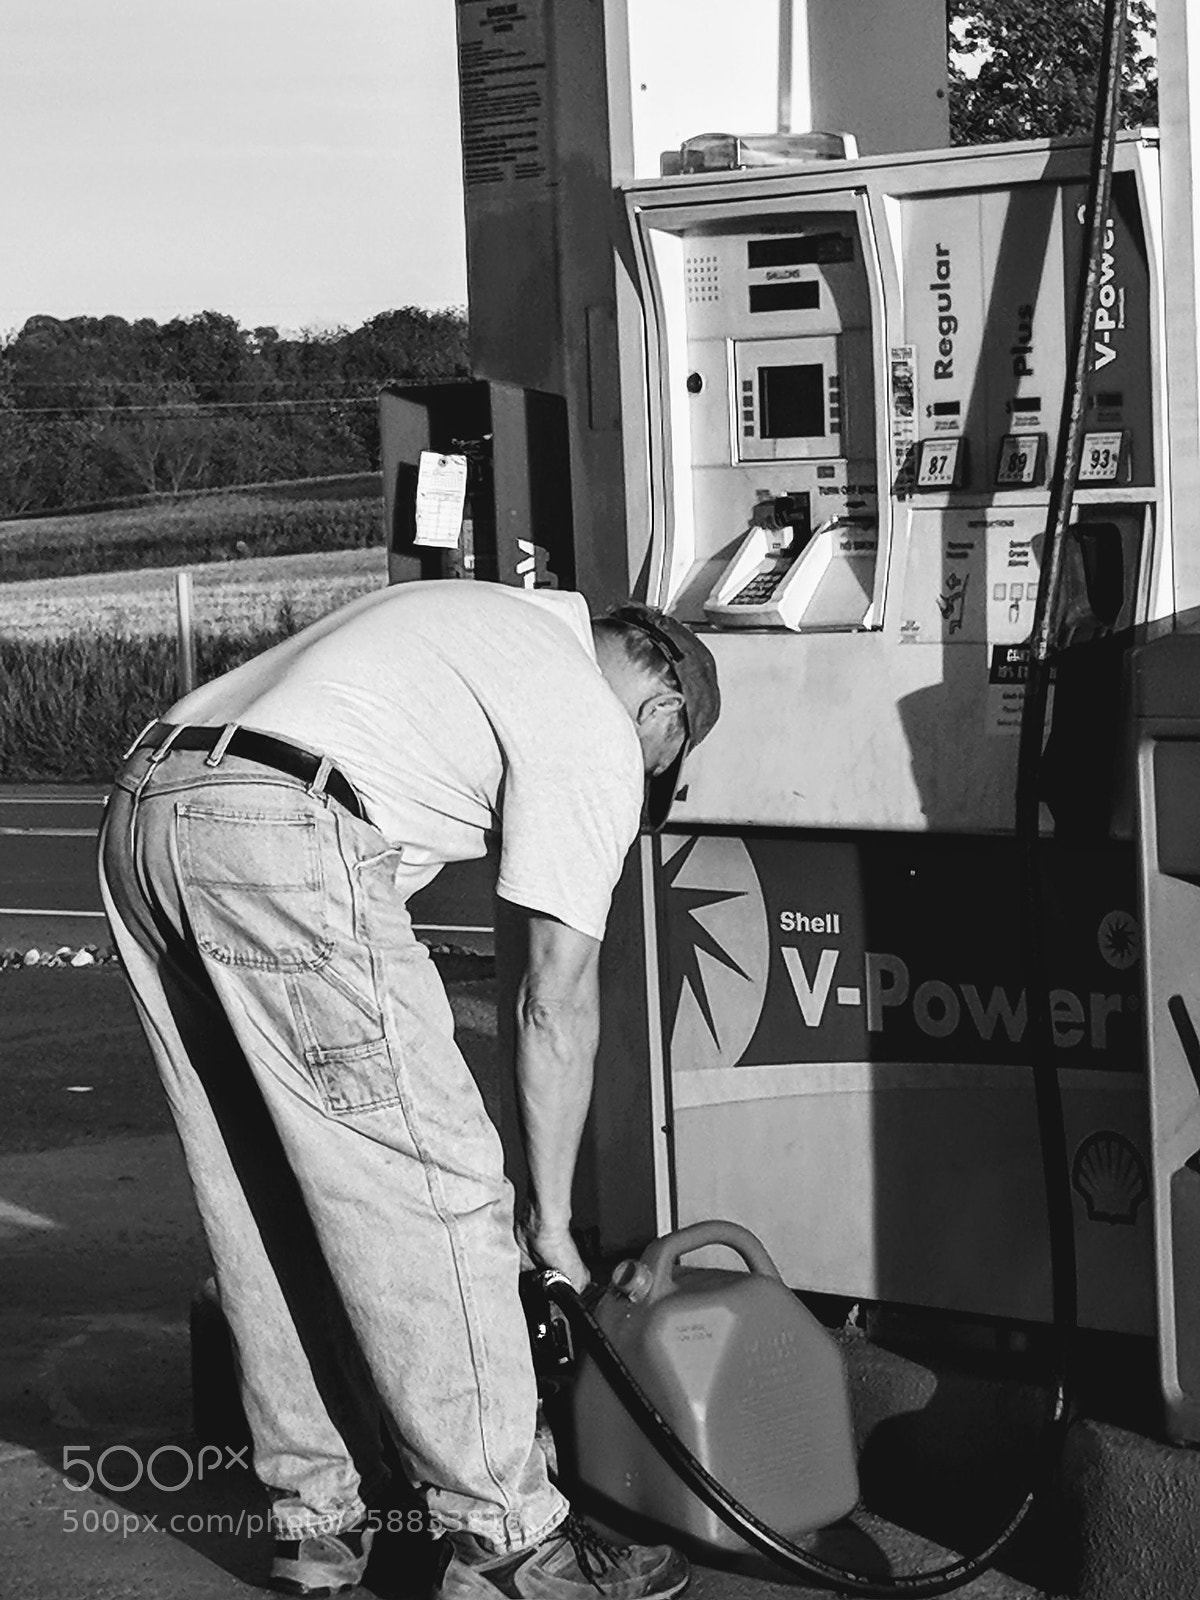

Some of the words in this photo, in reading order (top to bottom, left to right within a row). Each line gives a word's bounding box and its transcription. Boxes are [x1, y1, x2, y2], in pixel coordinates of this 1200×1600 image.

[930, 242, 958, 380] Regular
[1010, 303, 1034, 377] Plus
[928, 455, 948, 475] 87
[1008, 452, 1027, 473] 89
[1090, 448, 1110, 469] 93
[780, 910, 841, 935] Shell
[780, 945, 1123, 1050] V-Power
